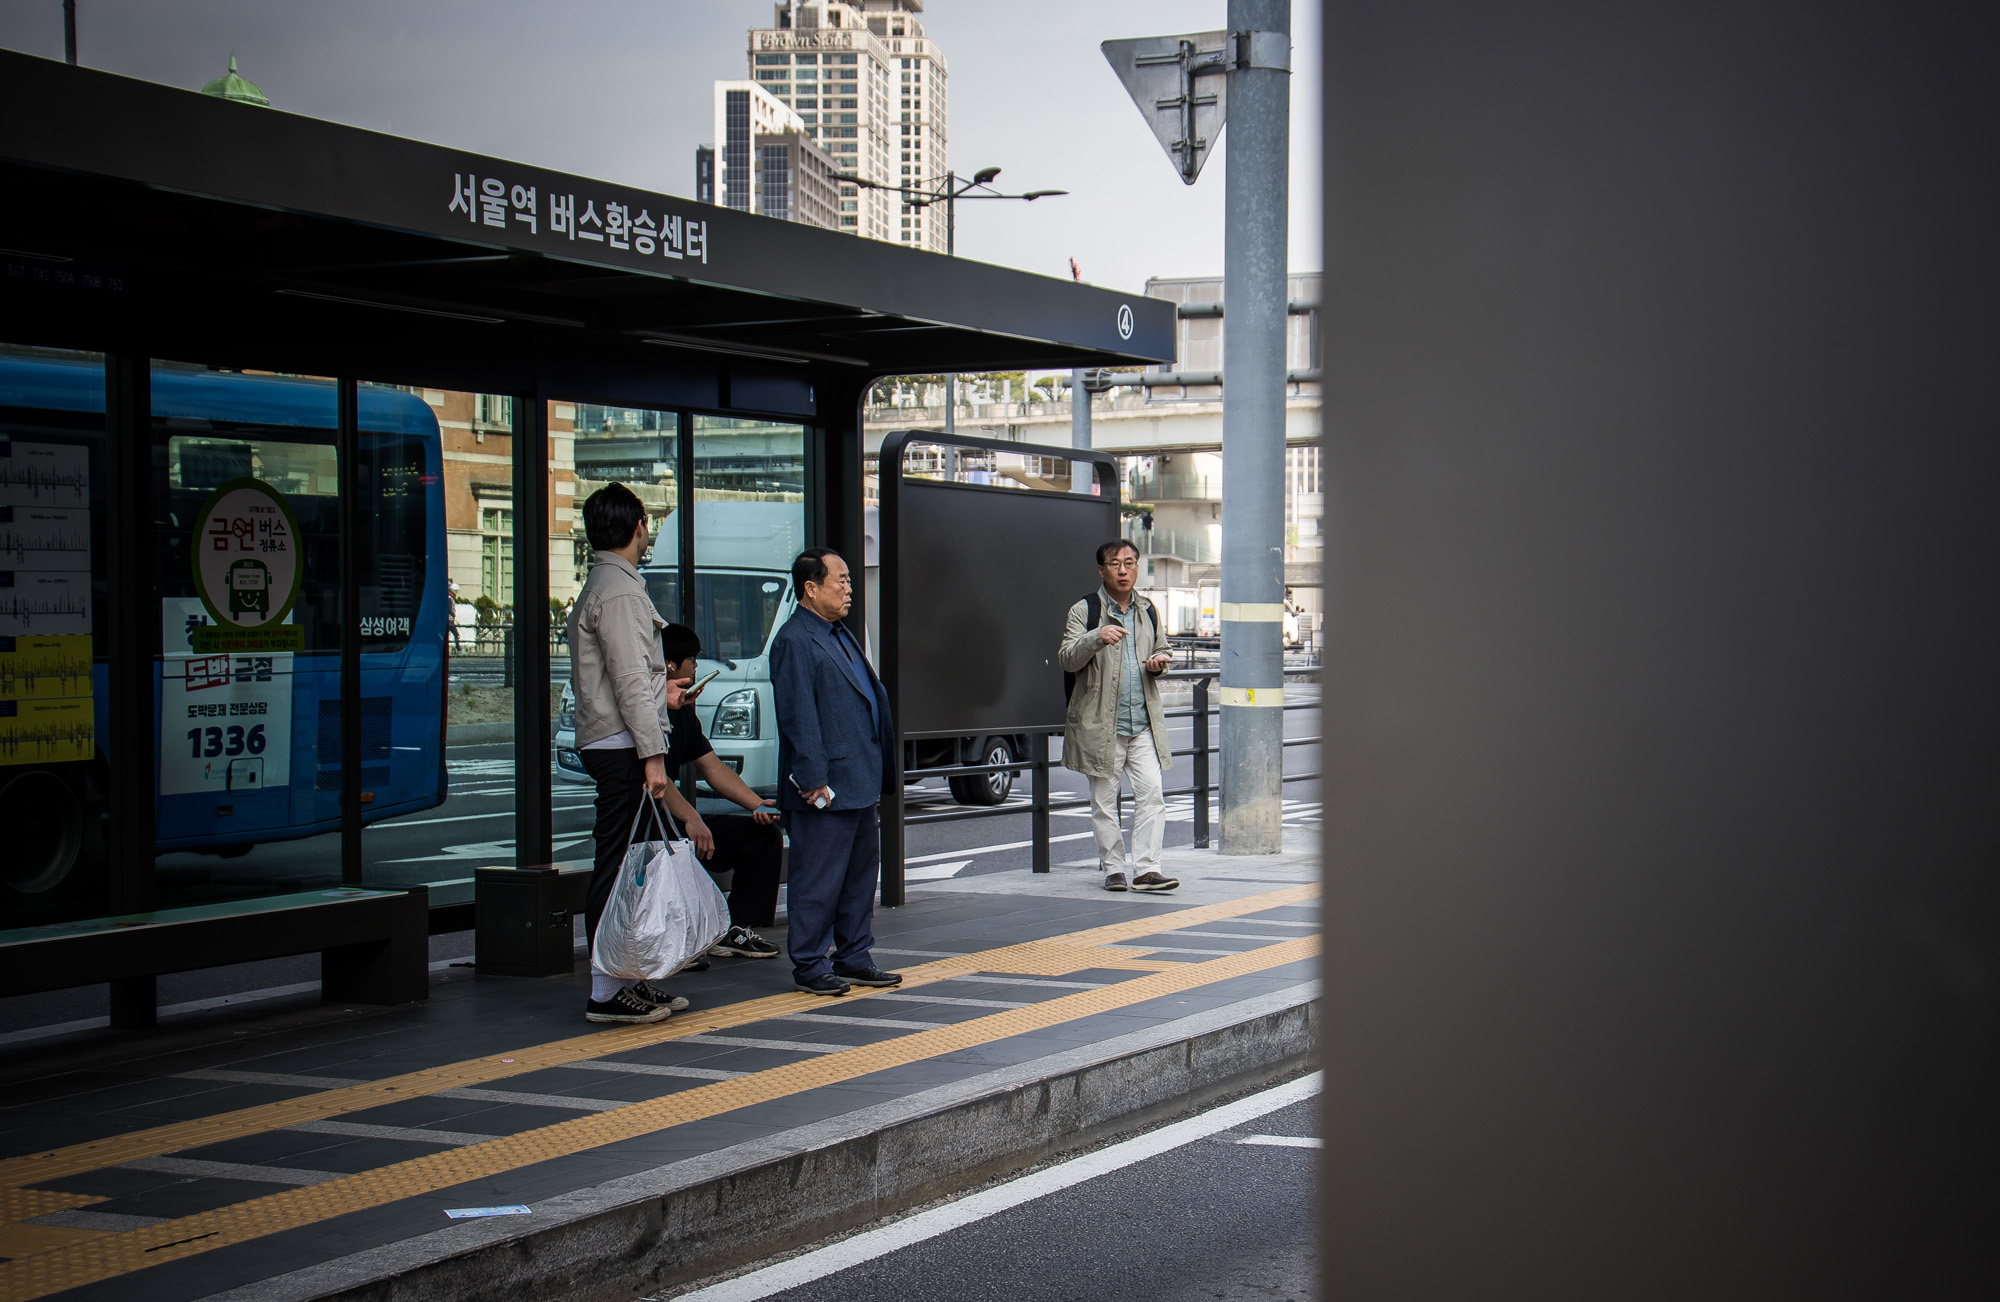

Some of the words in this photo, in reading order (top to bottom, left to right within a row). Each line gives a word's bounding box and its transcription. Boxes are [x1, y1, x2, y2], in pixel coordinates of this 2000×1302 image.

[762, 31, 810, 47] Brown
[813, 31, 851, 47] Stone
[448, 173, 537, 234] 서울역
[549, 193, 708, 265] 버스환승센터
[32, 266, 50, 281] 742
[107, 277, 125, 291] 752
[208, 516, 255, 552] 금연
[258, 518, 287, 537] 버스
[259, 539, 287, 553] 정류소
[359, 616, 410, 637] 삼성여객
[186, 656, 229, 689] 도박
[235, 656, 273, 682] 근절
[187, 703, 227, 718] 도박문제
[229, 702, 268, 716] 전문상담
[187, 724, 267, 758] 1336
